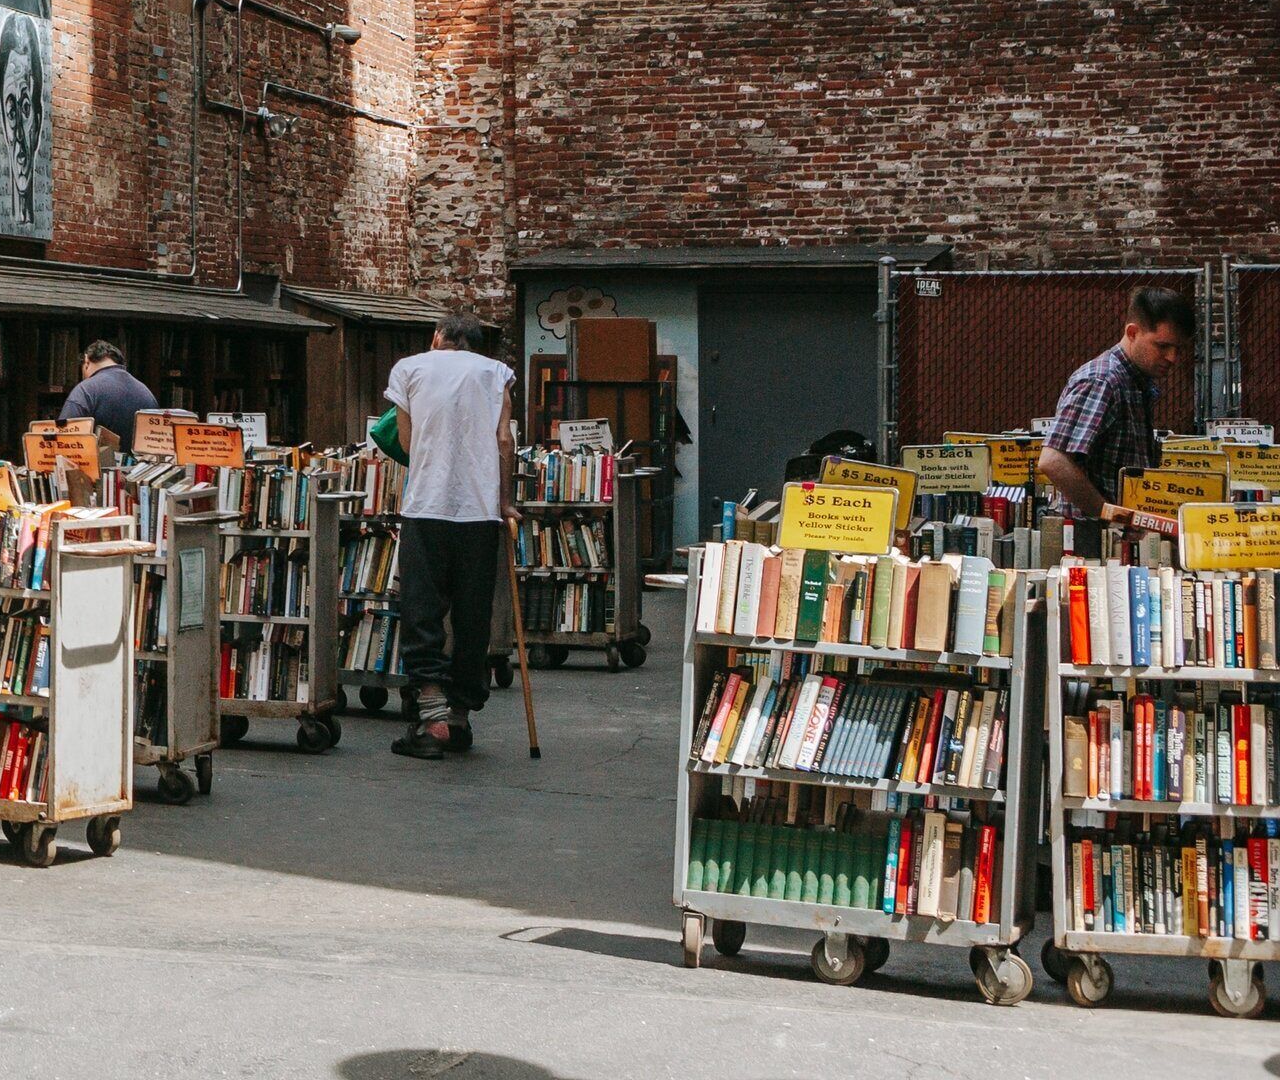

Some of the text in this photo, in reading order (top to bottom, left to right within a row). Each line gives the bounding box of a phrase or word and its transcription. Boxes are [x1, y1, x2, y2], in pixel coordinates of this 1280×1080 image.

[149, 418, 160, 426] $3
[187, 428, 229, 437] $3 Each
[39, 441, 84, 450] $3 Each
[917, 448, 973, 459] $5 Each
[1237, 451, 1252, 459] $5
[1177, 459, 1210, 468] Each
[841, 468, 898, 486] $5 Each
[1142, 480, 1204, 496] $5 Each
[806, 494, 872, 508] $5 Each
[1145, 497, 1174, 506] Books
[1137, 504, 1168, 515] Yellow
[808, 512, 866, 522] Books with
[1207, 514, 1229, 524] $5
[799, 520, 874, 532] Yellow Sticker
[1132, 514, 1174, 534] BERLIN
[1251, 529, 1277, 537] with
[745, 558, 753, 570] The
[744, 571, 752, 582] PC
[1111, 571, 1124, 625] MOZART
[805, 704, 827, 744] ZONE
